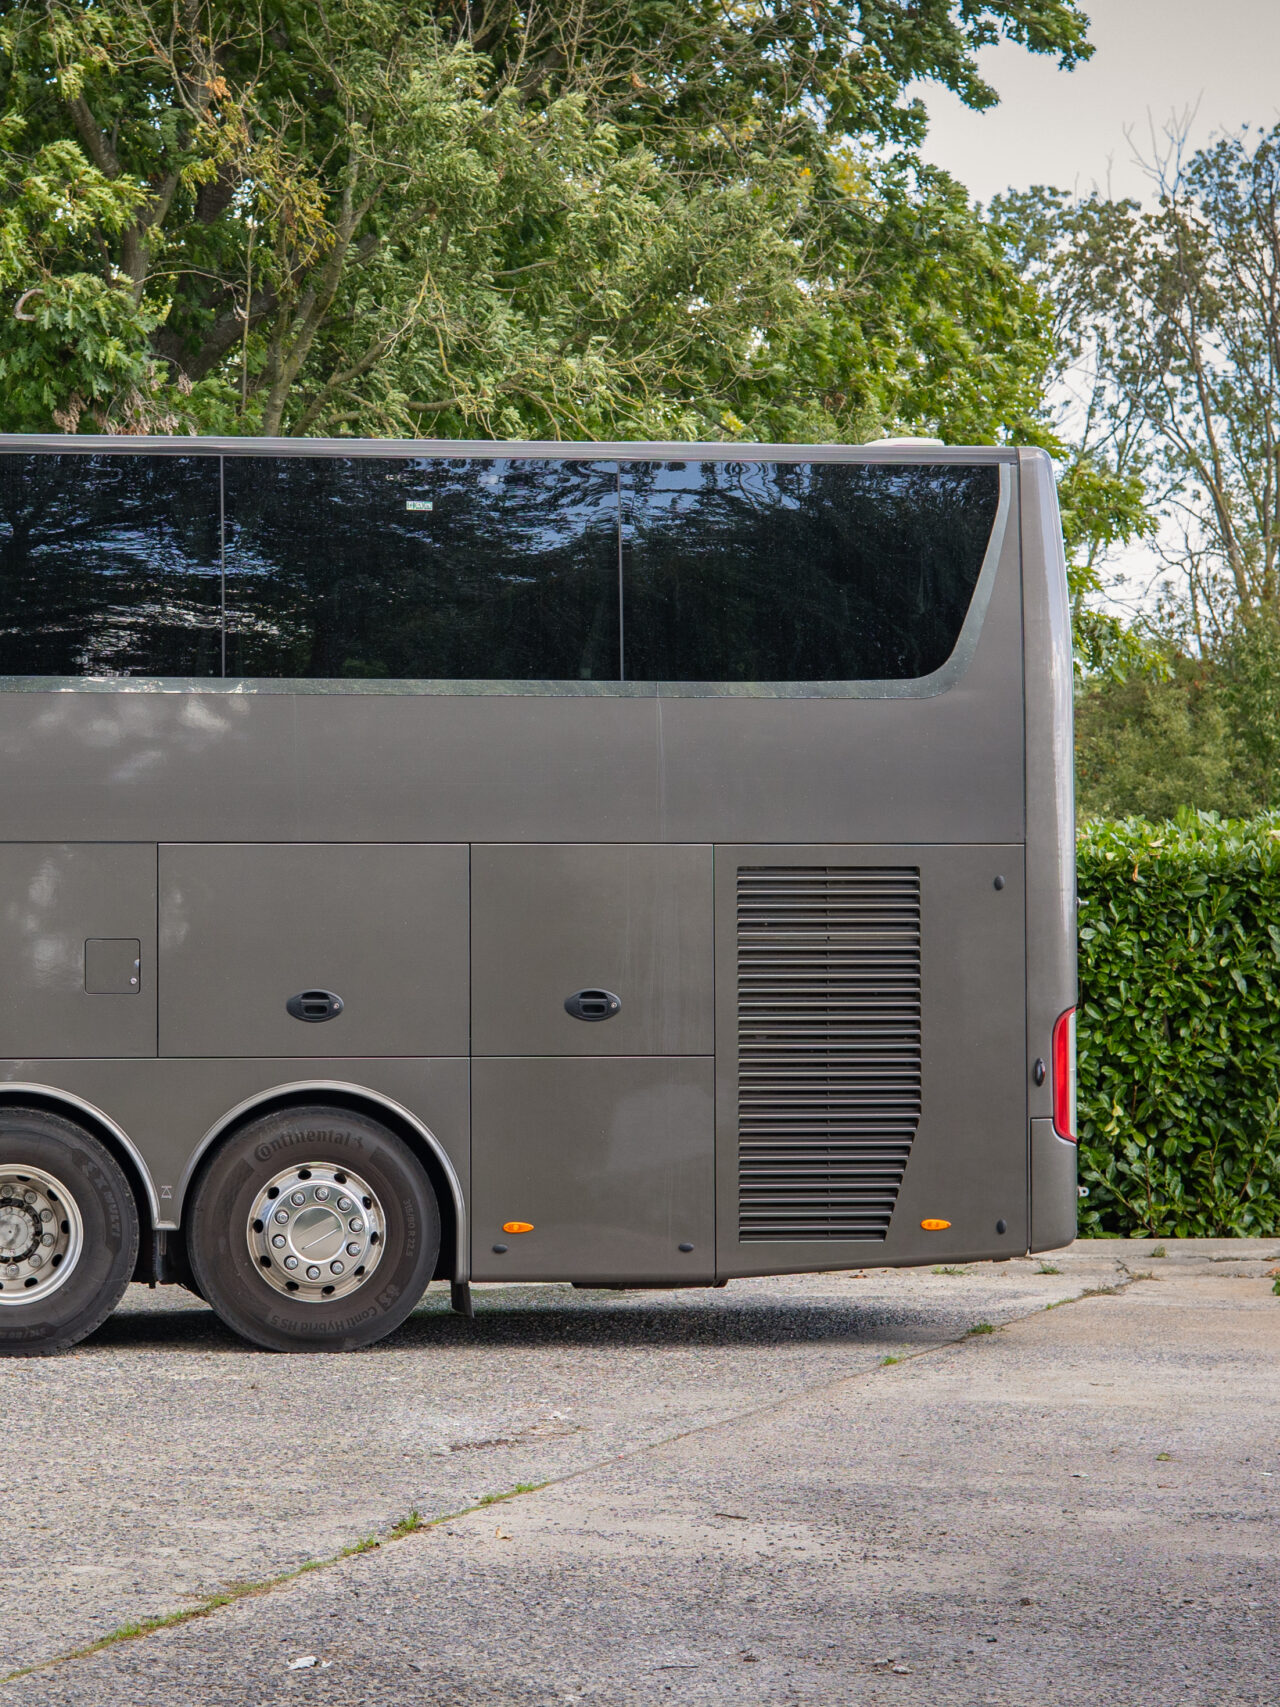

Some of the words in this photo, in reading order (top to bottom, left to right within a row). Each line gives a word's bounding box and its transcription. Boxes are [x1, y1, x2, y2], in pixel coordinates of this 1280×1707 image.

[254, 1129, 351, 1162] Continental
[301, 1319, 345, 1333] Hybrid
[347, 1306, 377, 1328] Conti
